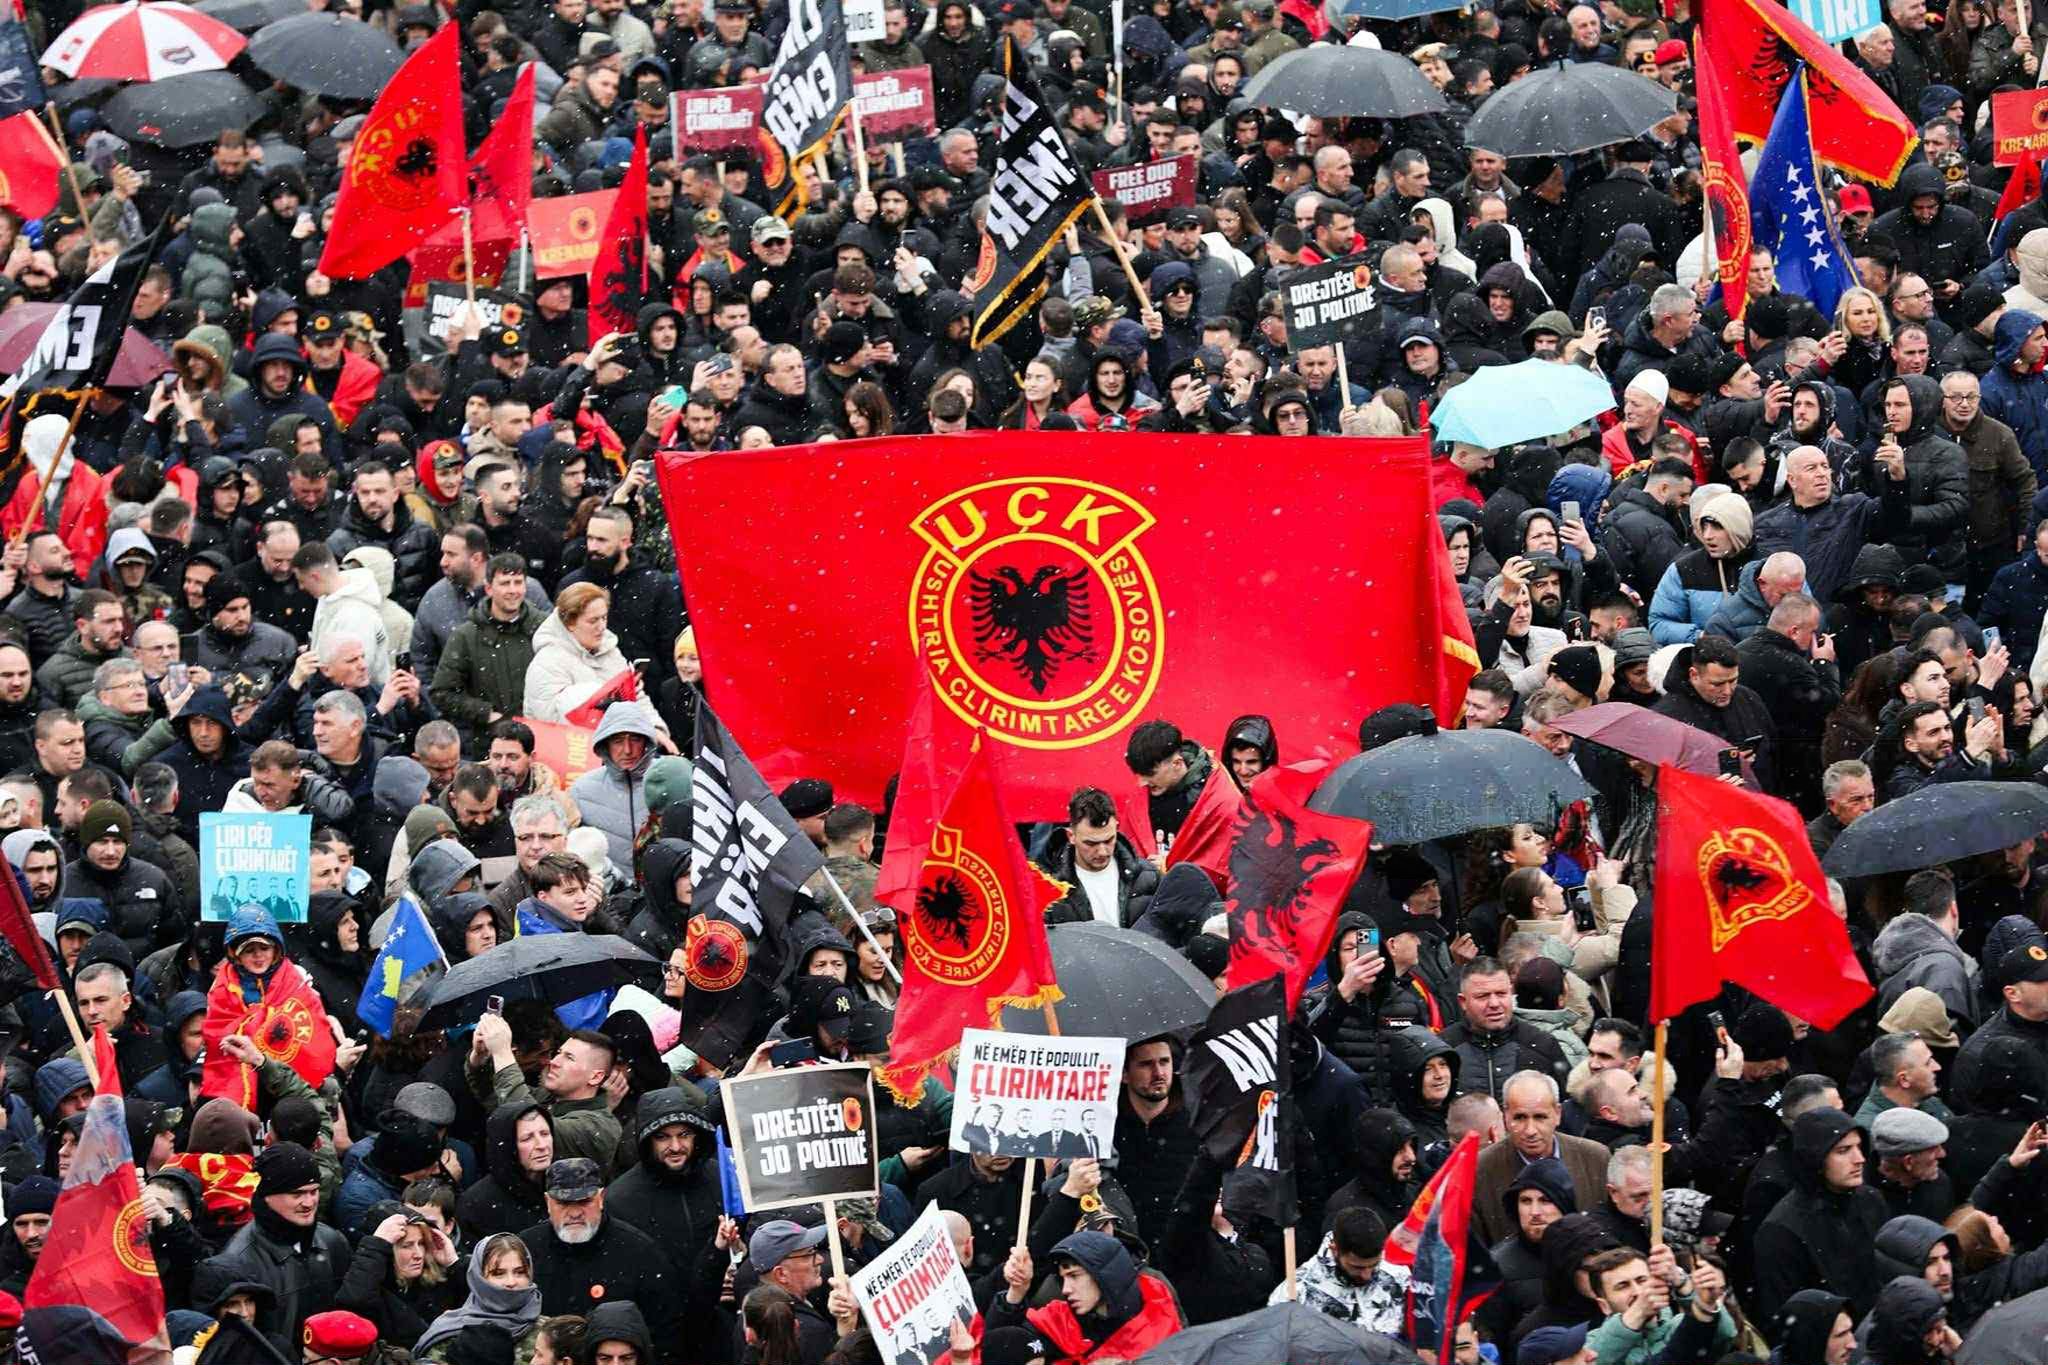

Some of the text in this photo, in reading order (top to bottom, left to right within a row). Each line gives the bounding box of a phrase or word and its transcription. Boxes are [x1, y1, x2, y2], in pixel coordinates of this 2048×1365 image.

[1109, 161, 1178, 190] FREE OUR
[1116, 181, 1173, 205] HEROES
[1290, 270, 1357, 306] DREJTËSI
[1294, 285, 1377, 330] JO POLITIKË
[934, 486, 1125, 548] UÇK
[921, 556, 1151, 735] USHTRIA ÇLIRIMTARE E KOSOVËS
[247, 821, 272, 848] PËR
[974, 1042, 1099, 1067] NË EMËR TË POPULLIT
[970, 1063, 1112, 1103] ÇLIRIMTARË
[752, 1097, 845, 1142] DREJTËSI
[760, 1129, 868, 1177] JO POLITIKË
[865, 1276, 879, 1299] NË
[878, 1260, 904, 1291] EMËR
[902, 1249, 914, 1271] TË
[872, 1229, 955, 1337] ÇLIRIMTARË
